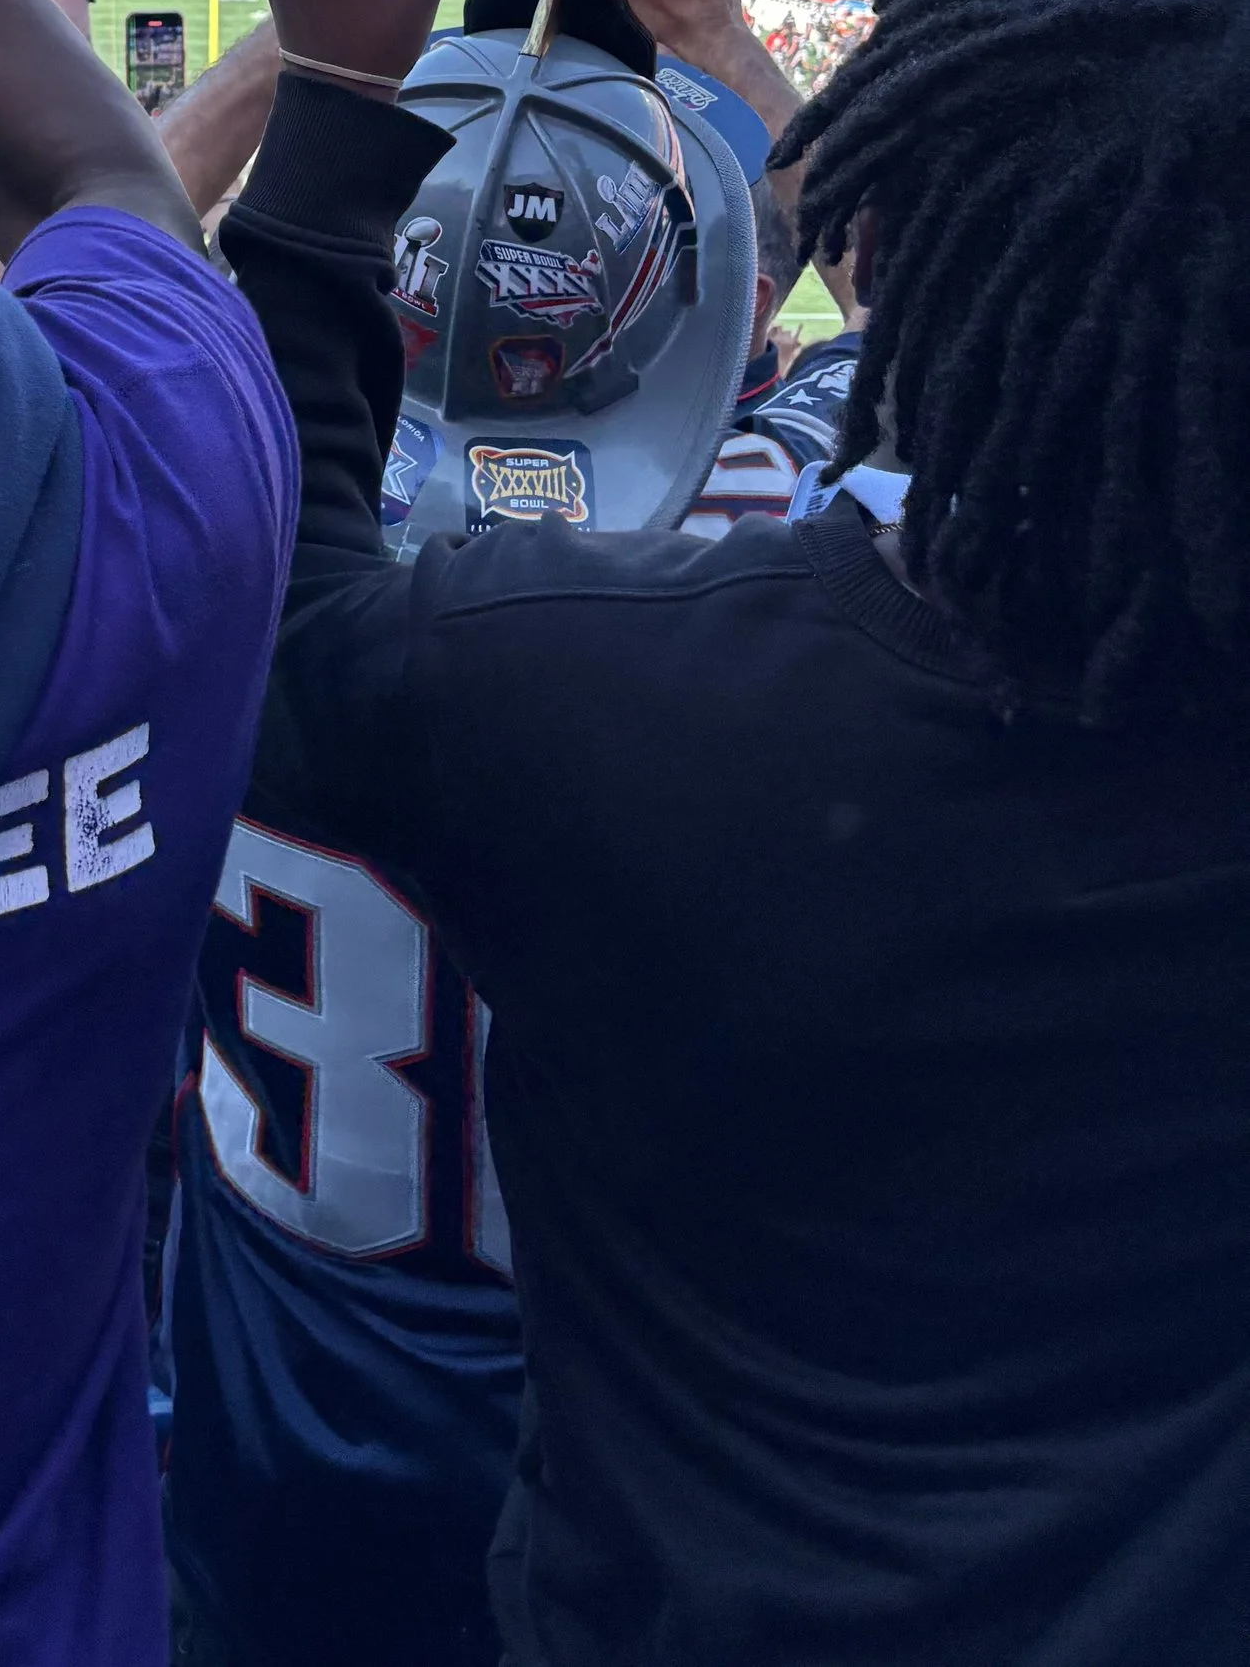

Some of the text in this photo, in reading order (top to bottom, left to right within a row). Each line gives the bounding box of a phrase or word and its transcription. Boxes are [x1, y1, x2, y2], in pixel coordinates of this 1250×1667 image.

[507, 193, 557, 222] JM
[494, 246, 564, 269] SUPER BOWL
[477, 262, 597, 298] XXXV
[506, 458, 549, 467] SUPER
[488, 462, 569, 504] XXXVIII
[510, 498, 549, 508] BOWL
